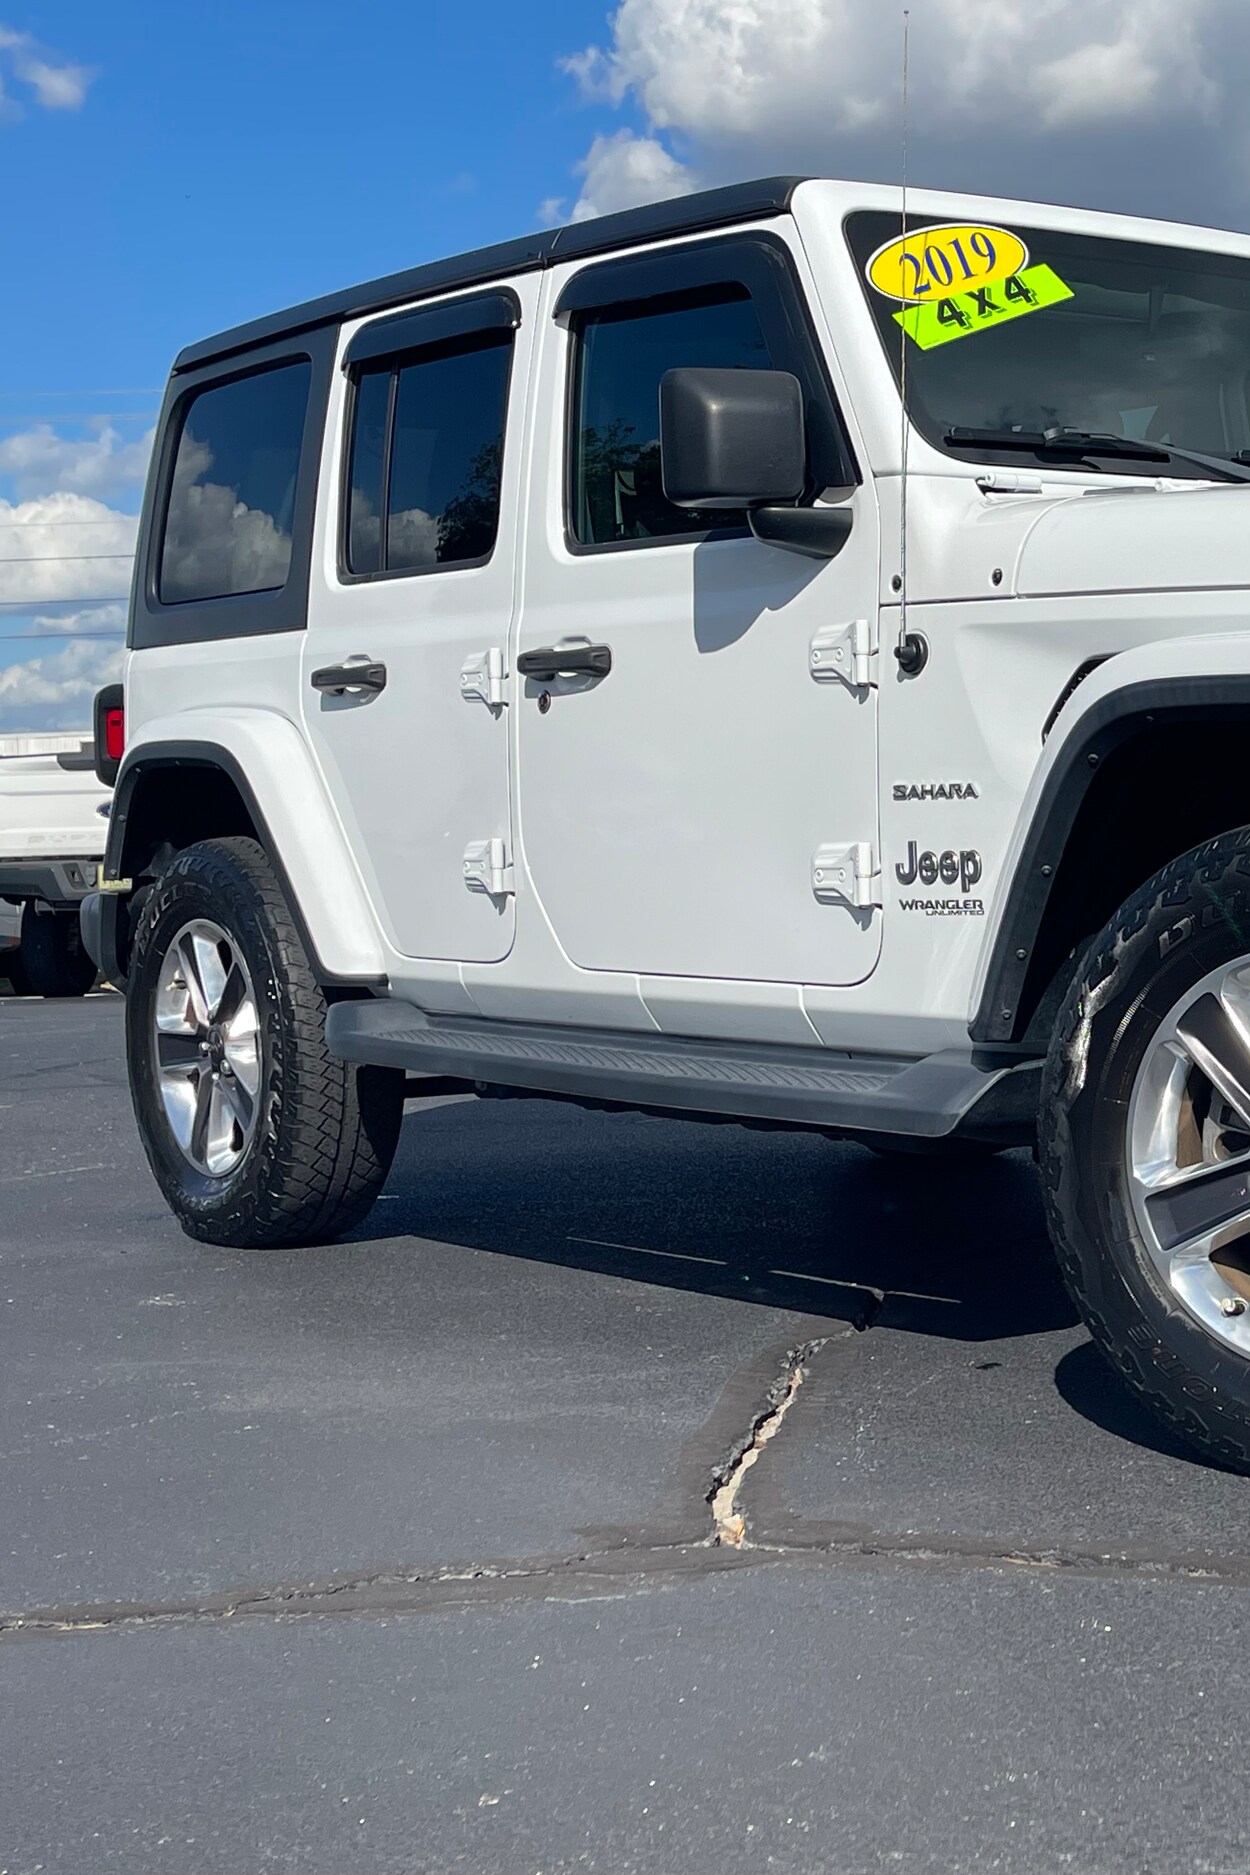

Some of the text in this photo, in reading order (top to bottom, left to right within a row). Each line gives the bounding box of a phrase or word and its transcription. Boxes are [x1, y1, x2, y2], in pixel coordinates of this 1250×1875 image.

[898, 231, 996, 295] 2019
[892, 783, 979, 801] SAHARA
[895, 840, 982, 893] Jeep
[899, 898, 984, 911] WRANGLER
